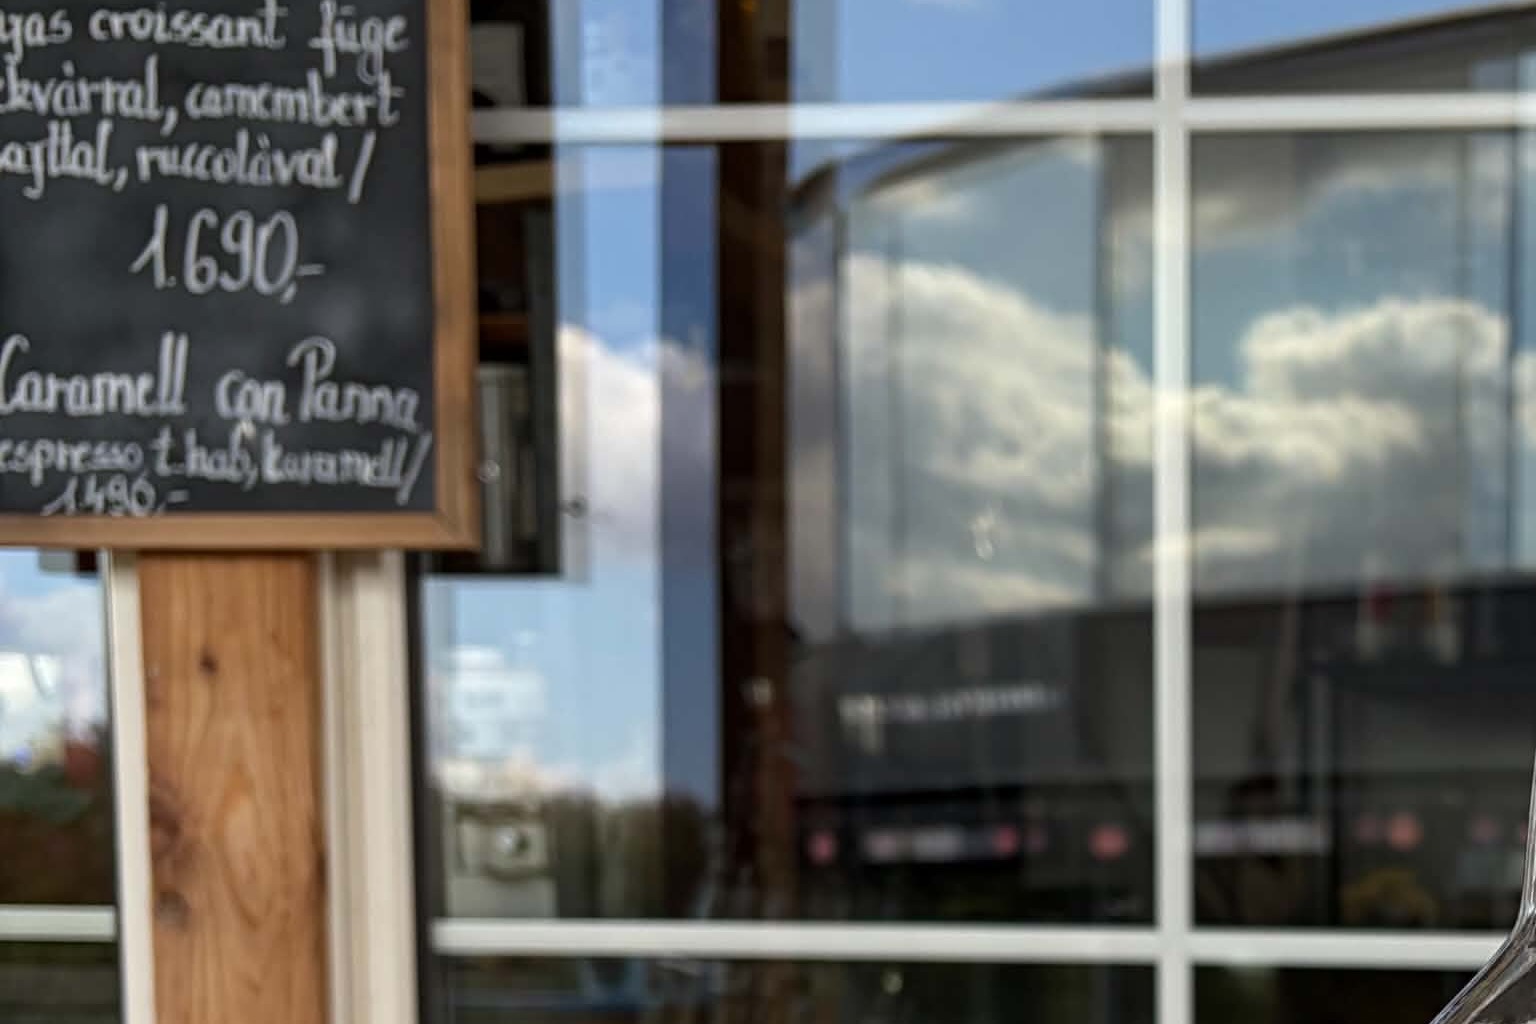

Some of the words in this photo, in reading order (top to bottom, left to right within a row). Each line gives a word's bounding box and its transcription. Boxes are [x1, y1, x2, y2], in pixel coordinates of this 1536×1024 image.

[89, 0, 287, 50] croissant
[308, 1, 408, 84] füge
[0, 53, 177, 134] kvárral,
[184, 68, 403, 127] camembert
[0, 120, 128, 200] ajttal,
[0, 331, 190, 417] Caramell
[287, 335, 421, 432] Panna
